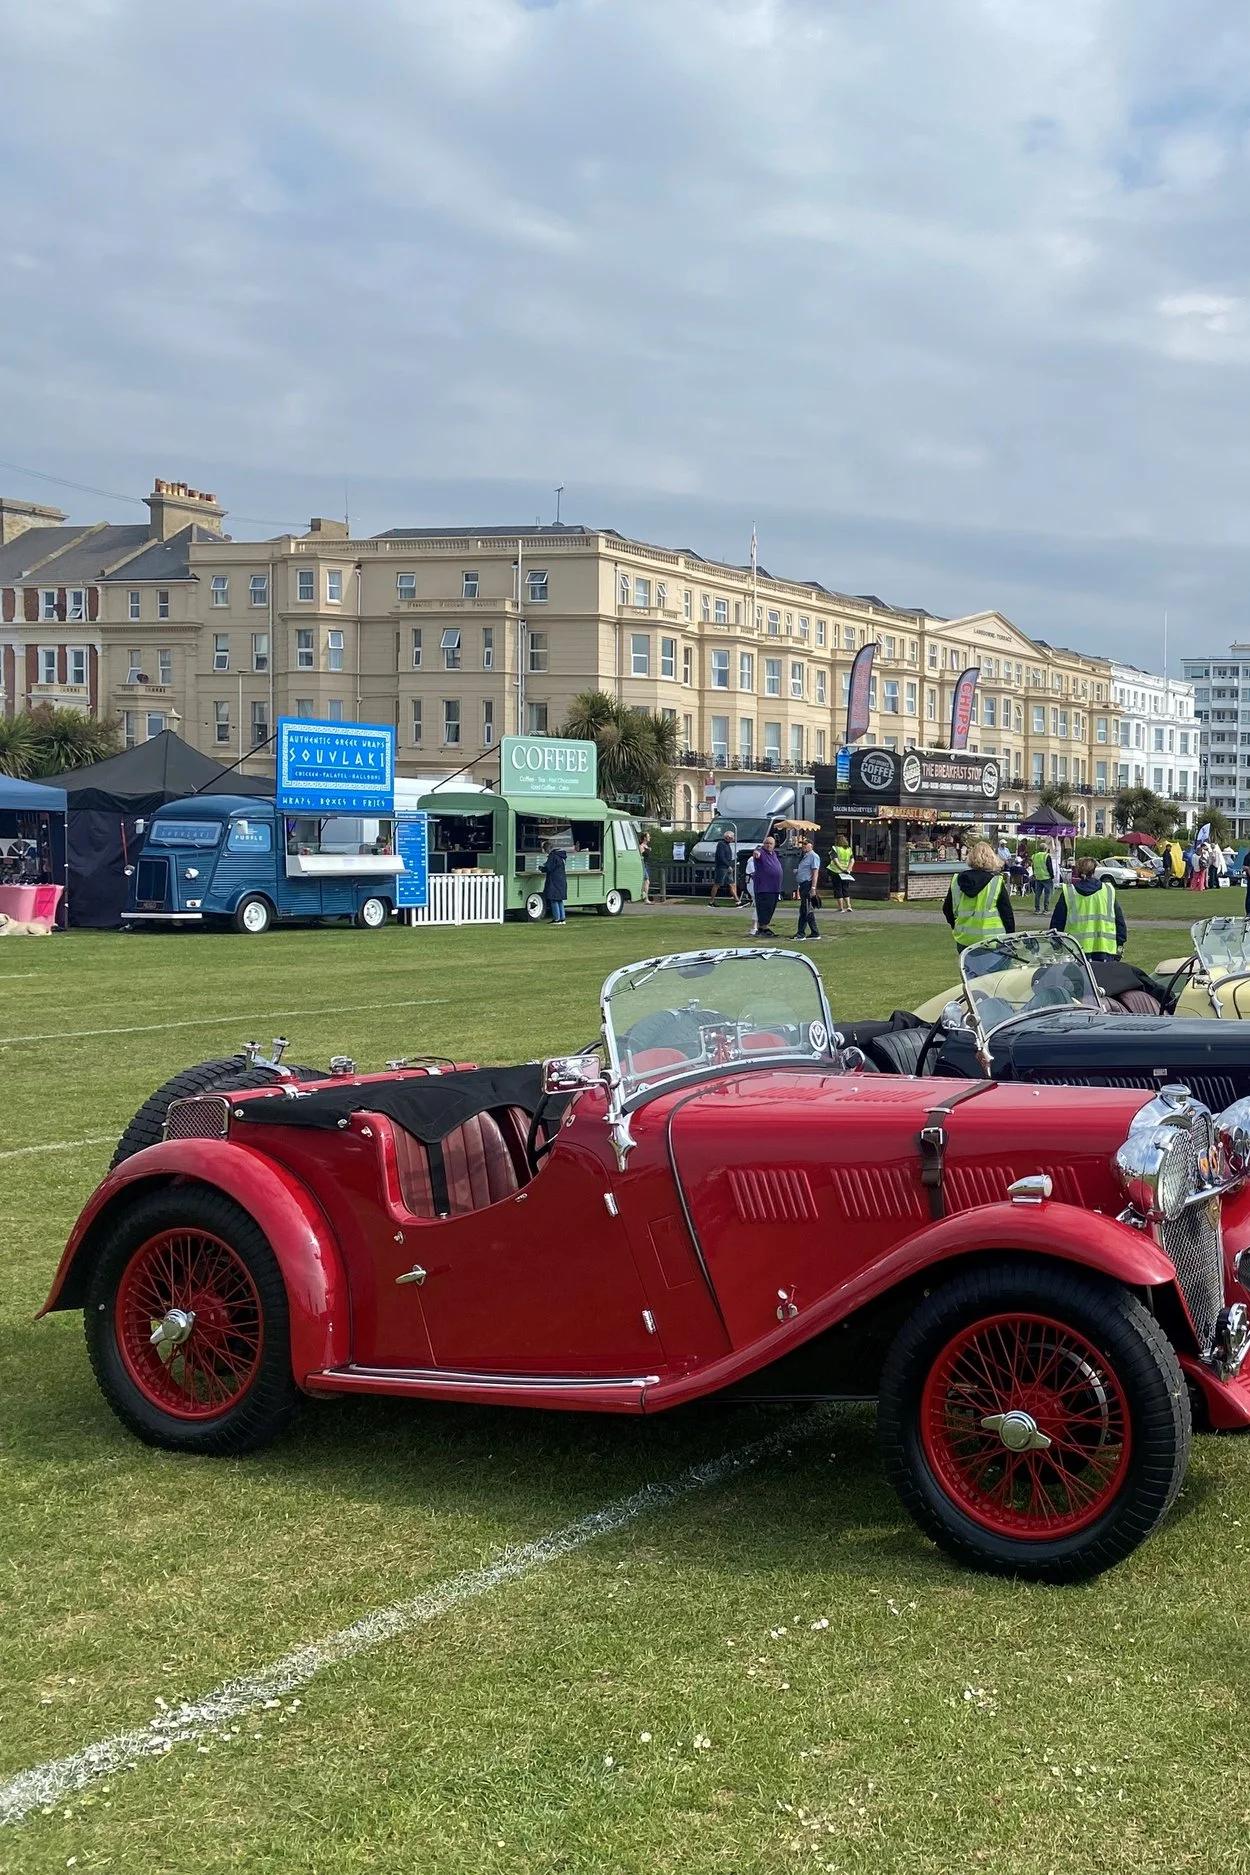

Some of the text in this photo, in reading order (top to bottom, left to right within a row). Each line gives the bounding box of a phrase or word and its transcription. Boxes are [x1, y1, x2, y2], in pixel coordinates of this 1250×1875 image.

[957, 682, 973, 735] CHIPS
[289, 735, 385, 749] AUTHENTIC GREEK WRAPS
[289, 747, 385, 767] SOUVLAKI
[512, 745, 589, 772] COFFEE
[861, 762, 894, 779] COFFEE
[870, 774, 882, 784] TEA
[922, 763, 934, 776] THE
[934, 764, 967, 780] BREAKFAST
[967, 767, 982, 780] STOP
[320, 798, 347, 806] BOXES
[363, 799, 385, 807] FRIES
